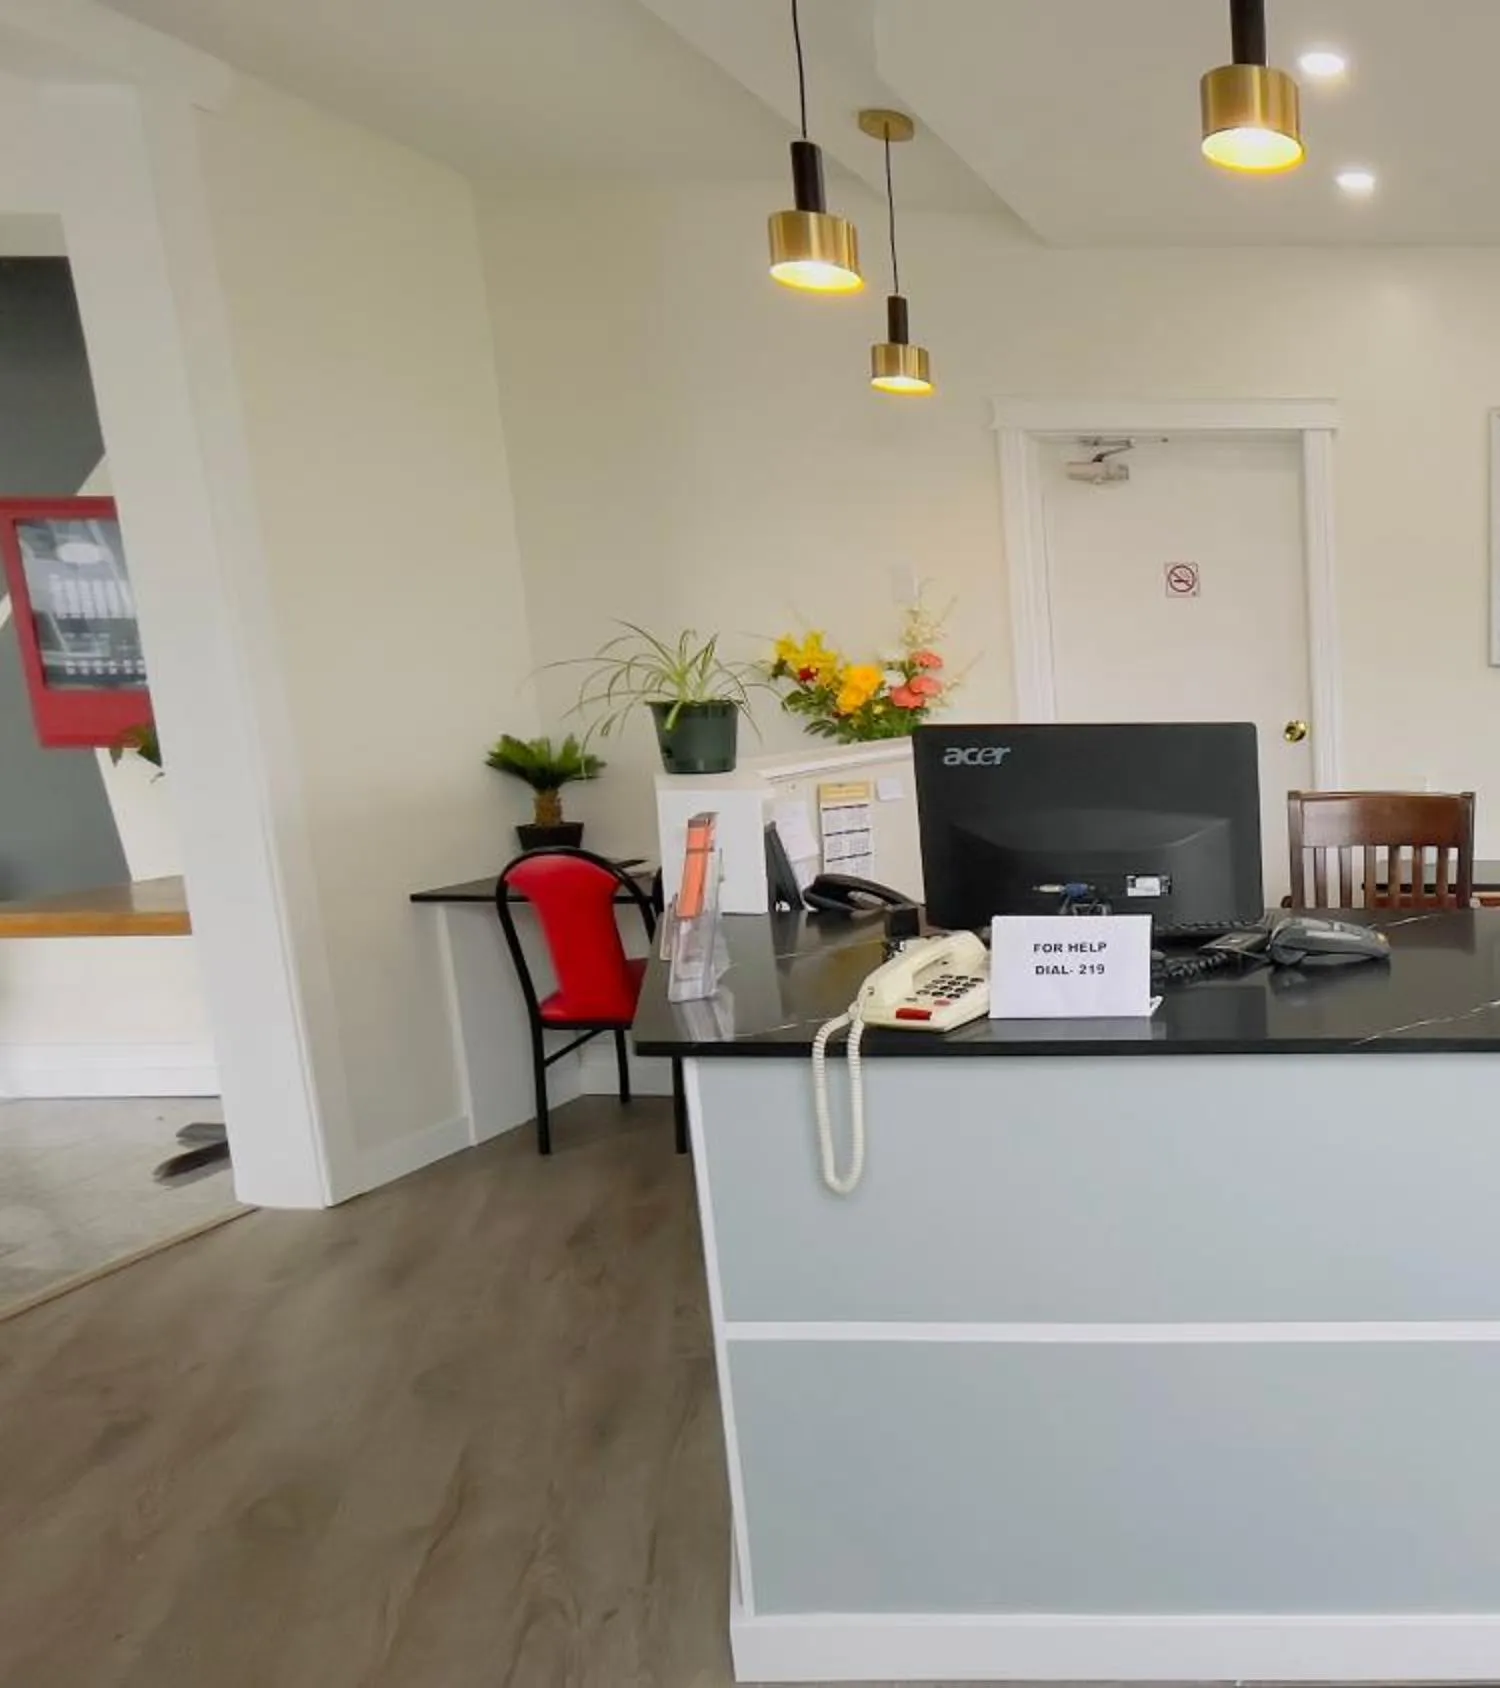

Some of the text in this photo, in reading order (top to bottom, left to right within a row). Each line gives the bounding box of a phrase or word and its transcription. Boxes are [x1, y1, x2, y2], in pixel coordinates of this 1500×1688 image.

[943, 747, 1012, 765] acer
[1033, 942, 1107, 953] FOR HELP
[1079, 963, 1105, 975] 219
